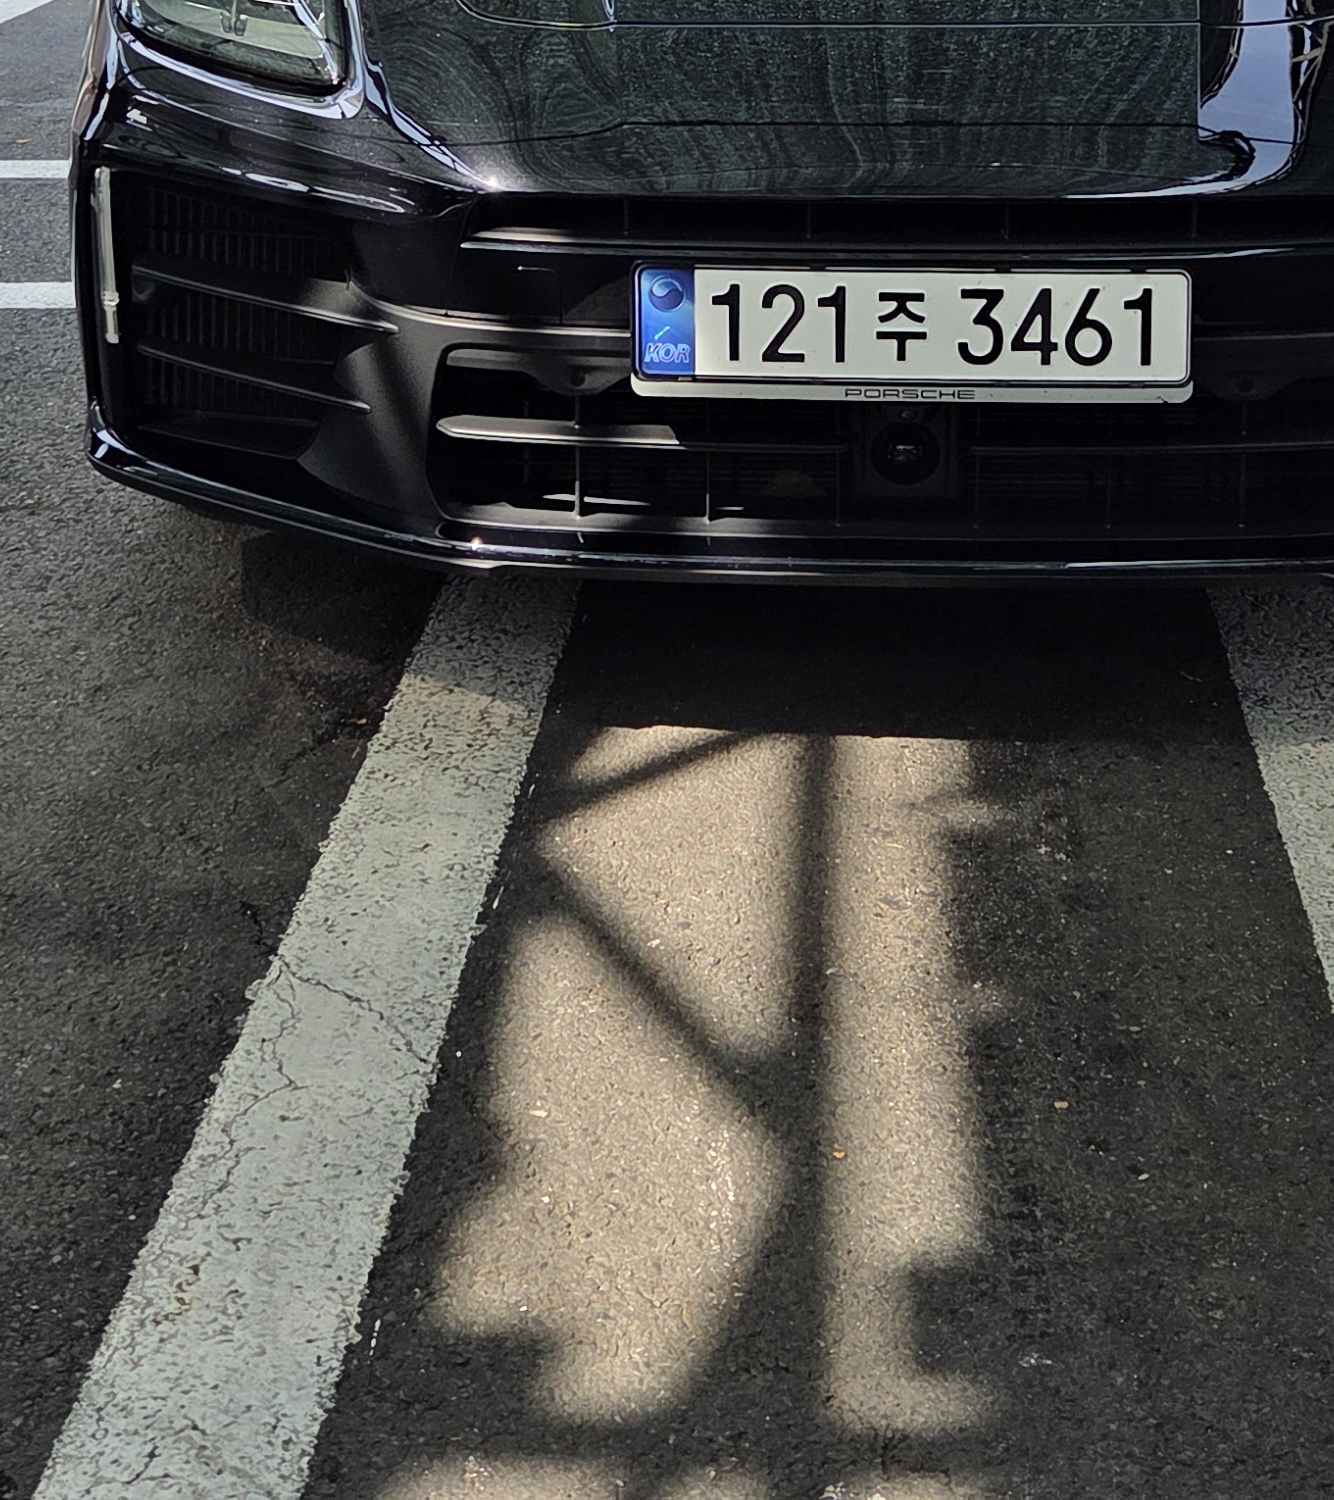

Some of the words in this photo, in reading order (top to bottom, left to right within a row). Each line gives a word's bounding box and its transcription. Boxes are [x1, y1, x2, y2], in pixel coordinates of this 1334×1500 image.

[711, 283, 927, 364] 121주
[957, 287, 1154, 367] 3461
[644, 342, 691, 363] KOR
[845, 386, 975, 400] PORSCHE
